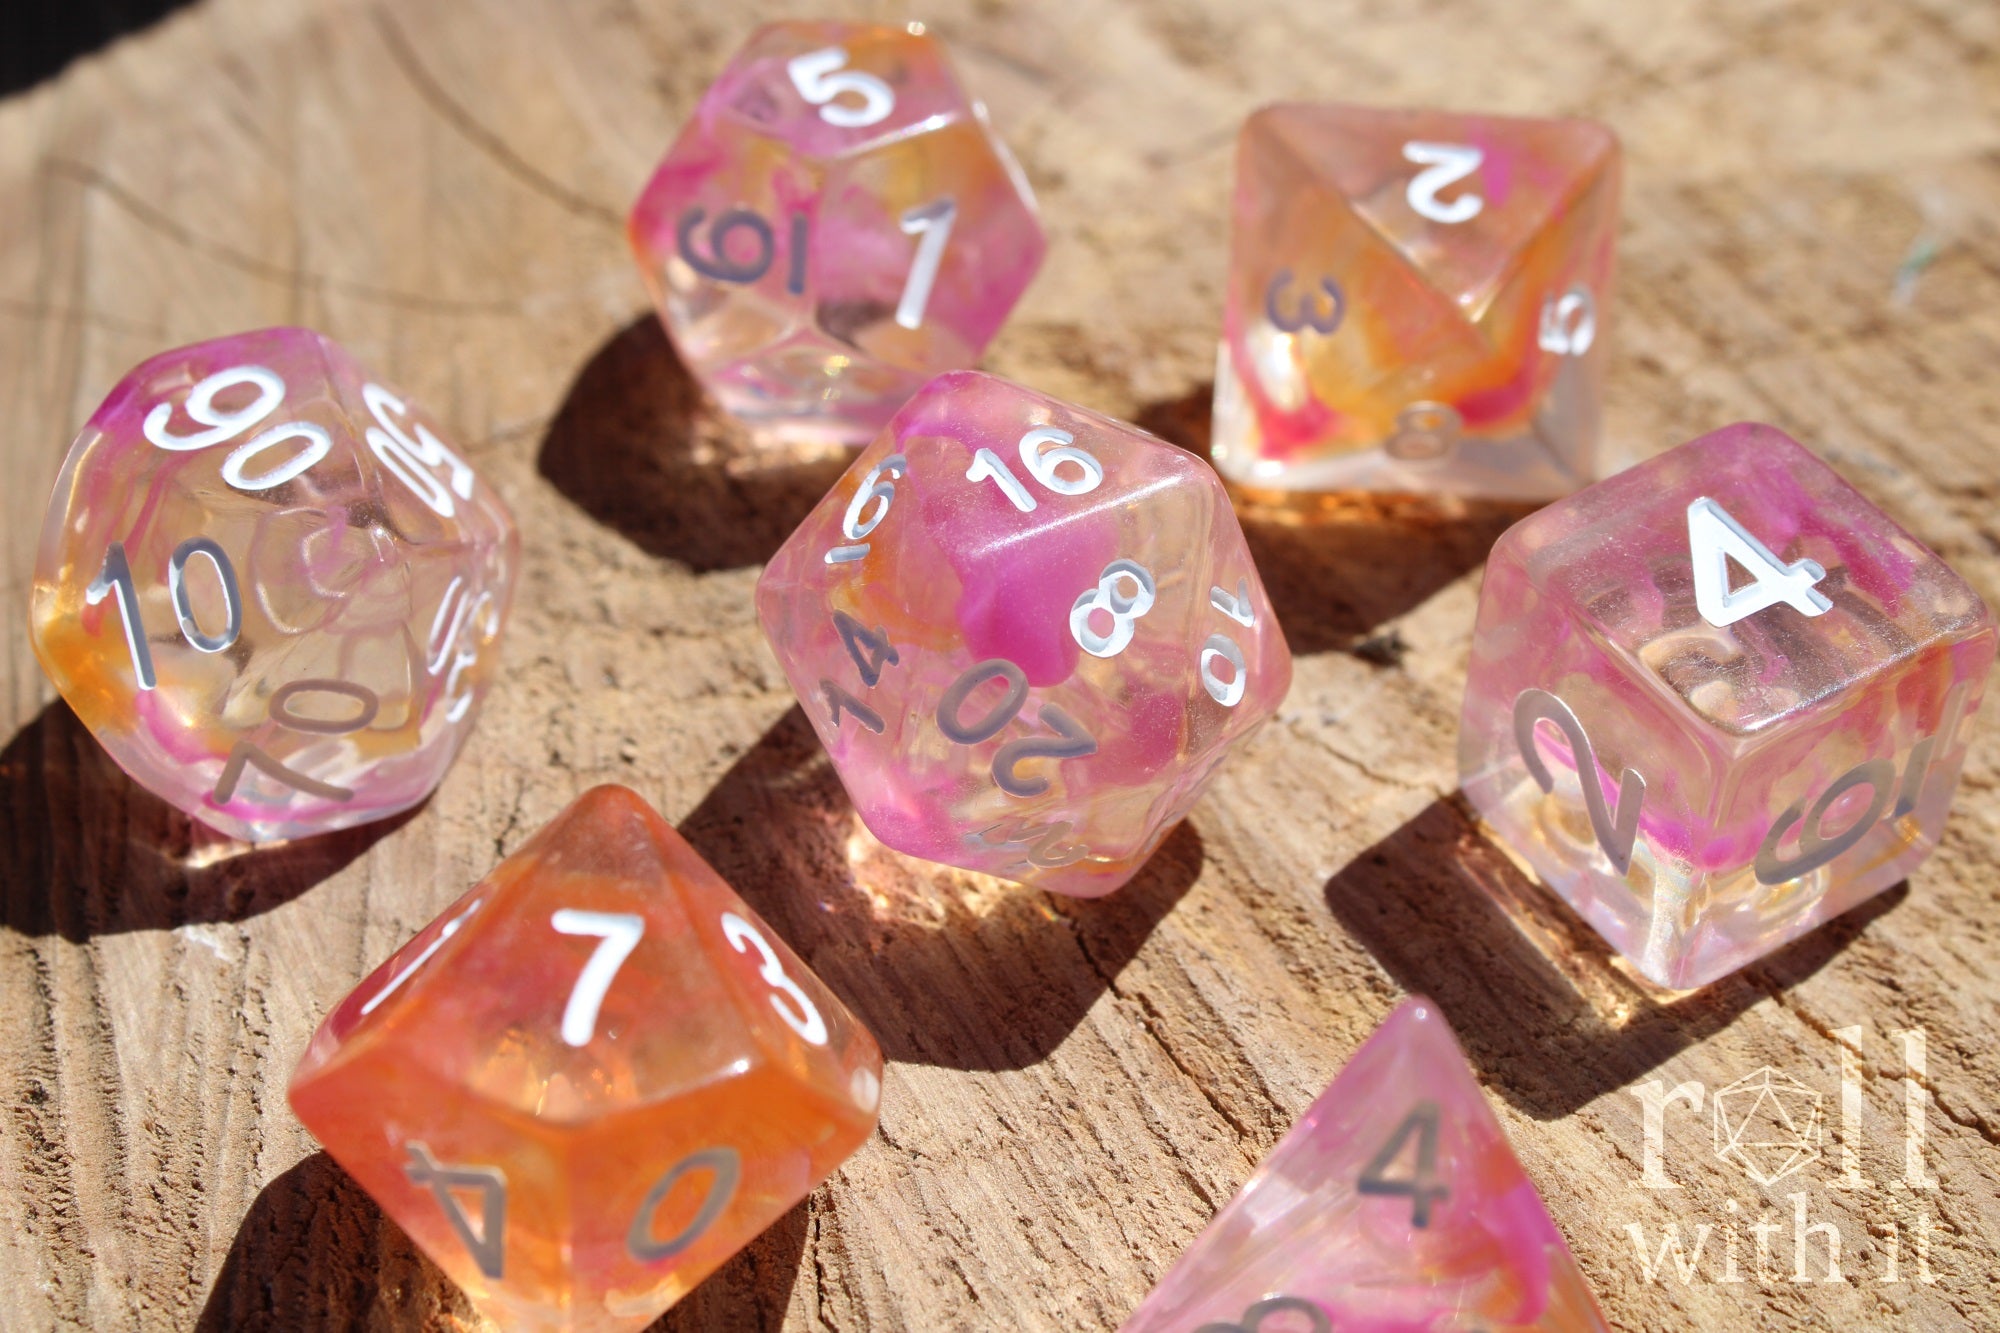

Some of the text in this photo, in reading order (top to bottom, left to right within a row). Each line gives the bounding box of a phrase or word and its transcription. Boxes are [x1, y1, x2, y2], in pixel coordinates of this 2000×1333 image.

[788, 47, 894, 128] 5
[1403, 140, 1484, 224] 2
[895, 198, 956, 331] 1
[1266, 268, 1345, 335] 3
[143, 365, 333, 491] 90
[362, 383, 475, 518] 50
[966, 426, 1104, 512] 16
[86, 537, 242, 691] 10
[1069, 558, 1156, 658] 8
[1687, 496, 1834, 628] 4
[818, 609, 900, 735] 14
[936, 658, 1097, 798] 20
[1513, 688, 1647, 877] 2
[551, 907, 645, 1047] 7
[721, 912, 829, 1046] 3
[405, 1141, 508, 1279] 4
[626, 1147, 741, 1263] 0
[1357, 1104, 1451, 1229] 4
